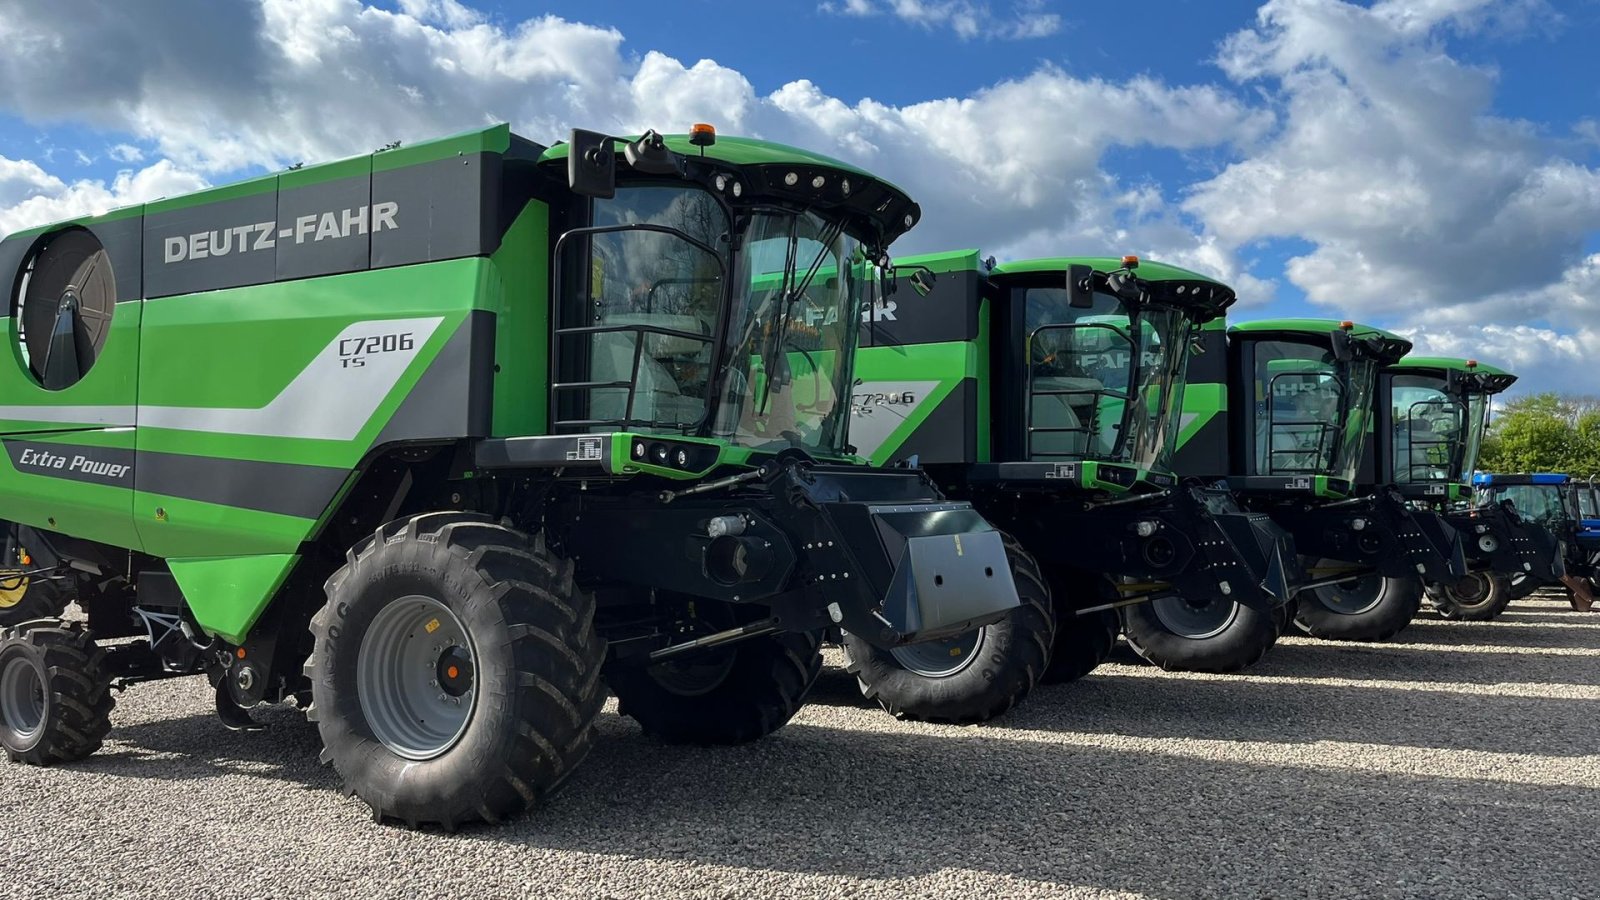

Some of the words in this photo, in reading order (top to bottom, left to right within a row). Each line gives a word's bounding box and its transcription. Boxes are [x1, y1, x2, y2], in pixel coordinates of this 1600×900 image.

[164, 201, 399, 264] DEUTZ-FAHR
[339, 332, 414, 357] C7206
[339, 356, 366, 368] TS
[19, 448, 67, 469] Extra
[69, 455, 131, 478] Power
